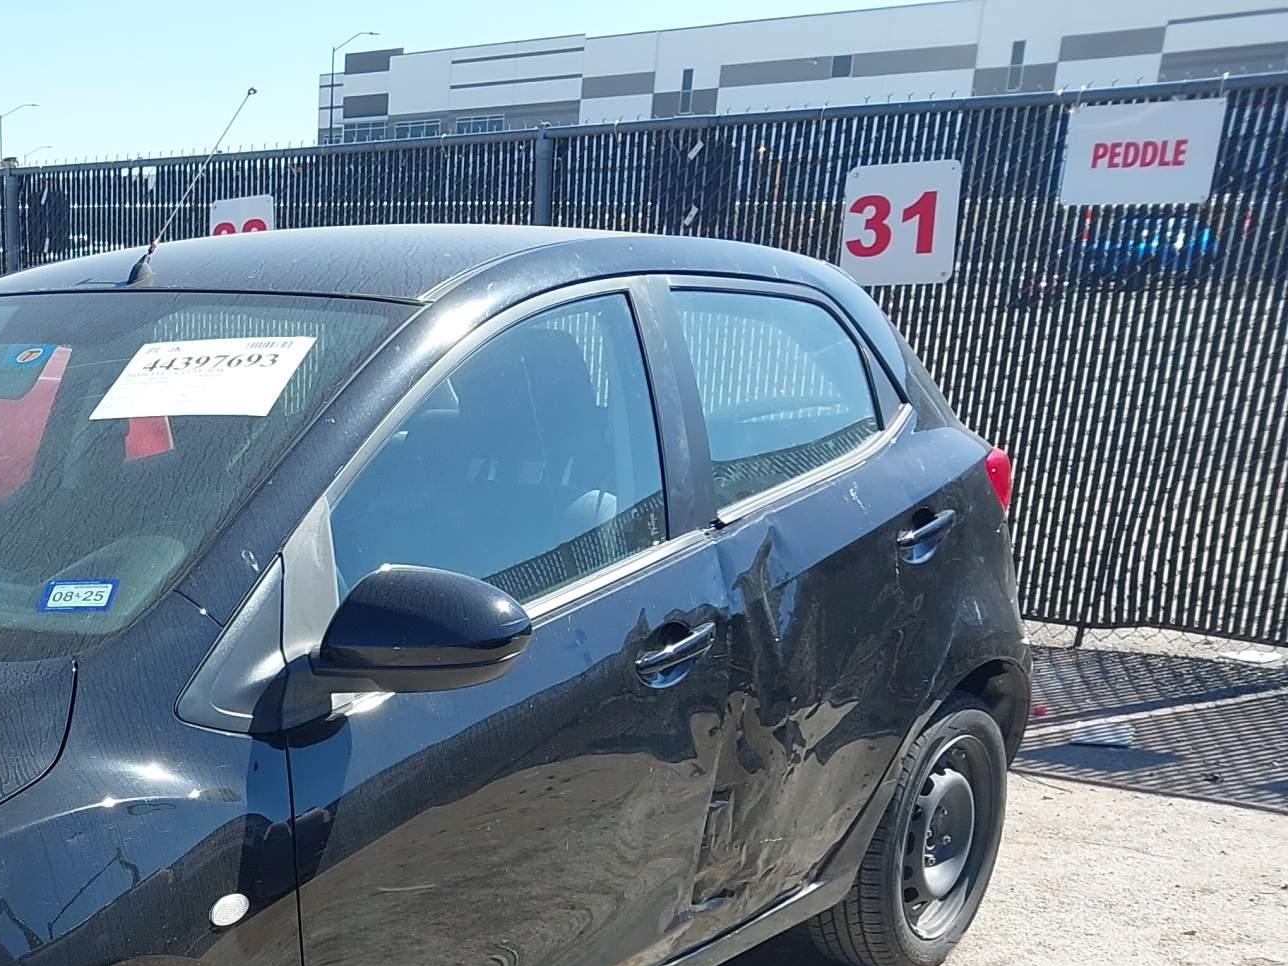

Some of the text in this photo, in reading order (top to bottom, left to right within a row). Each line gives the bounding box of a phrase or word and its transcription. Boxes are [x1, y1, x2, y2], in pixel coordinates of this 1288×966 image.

[1091, 139, 1188, 168] PEDDLE
[846, 190, 937, 257] 31
[143, 353, 280, 372] 44397693
